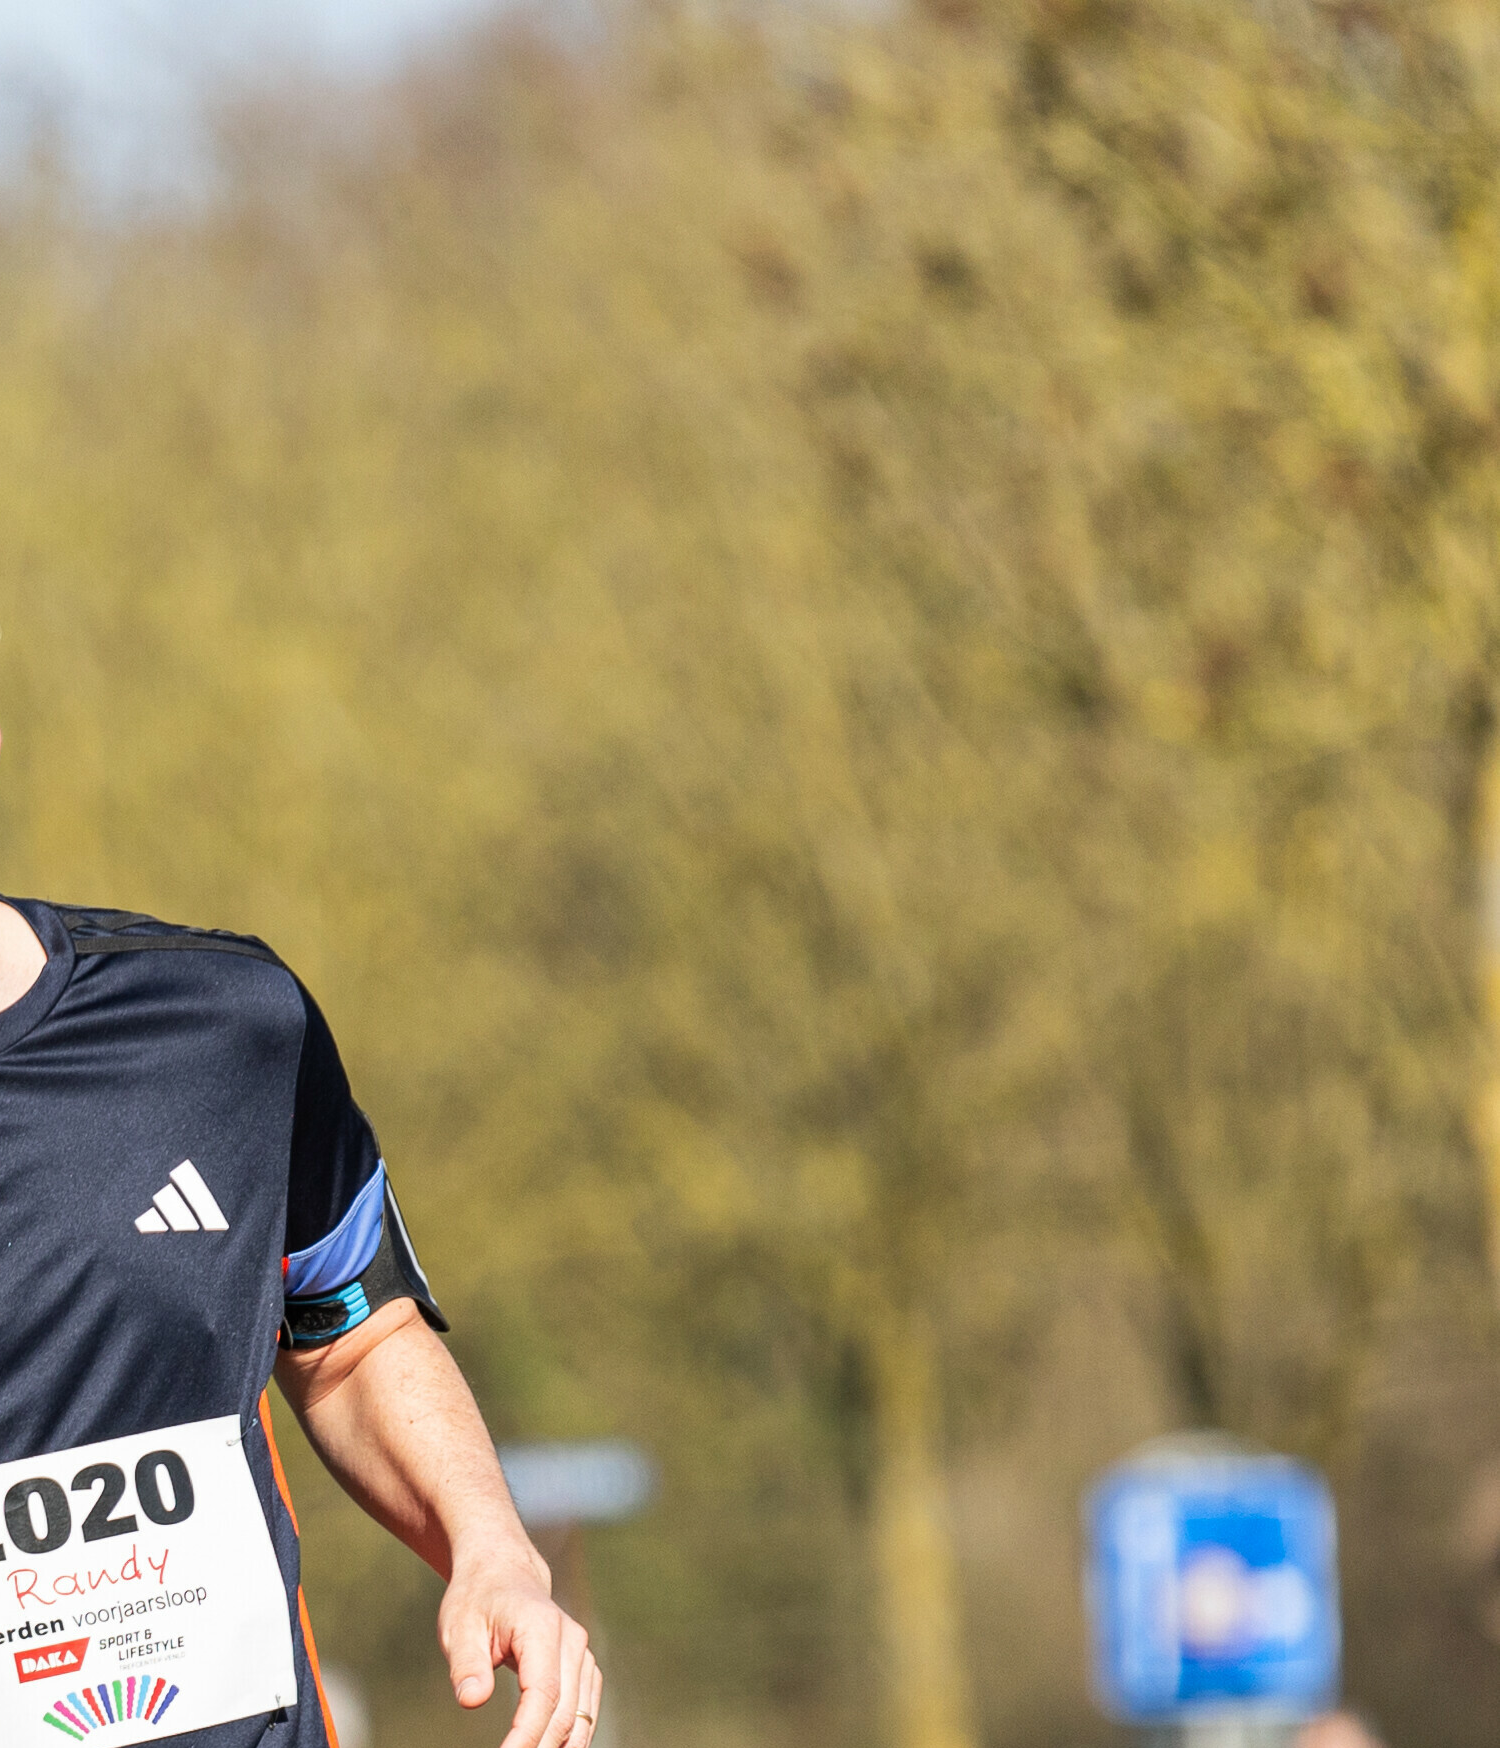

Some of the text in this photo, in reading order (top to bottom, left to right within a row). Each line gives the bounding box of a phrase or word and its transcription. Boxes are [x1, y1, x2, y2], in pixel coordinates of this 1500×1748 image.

[7, 1543, 170, 1610] Randy
[72, 1583, 208, 1630] voorjaarsloop
[99, 1631, 140, 1651] SPORT
[118, 1636, 185, 1661] LIFESTYLE
[21, 1649, 80, 1674] DAKA
